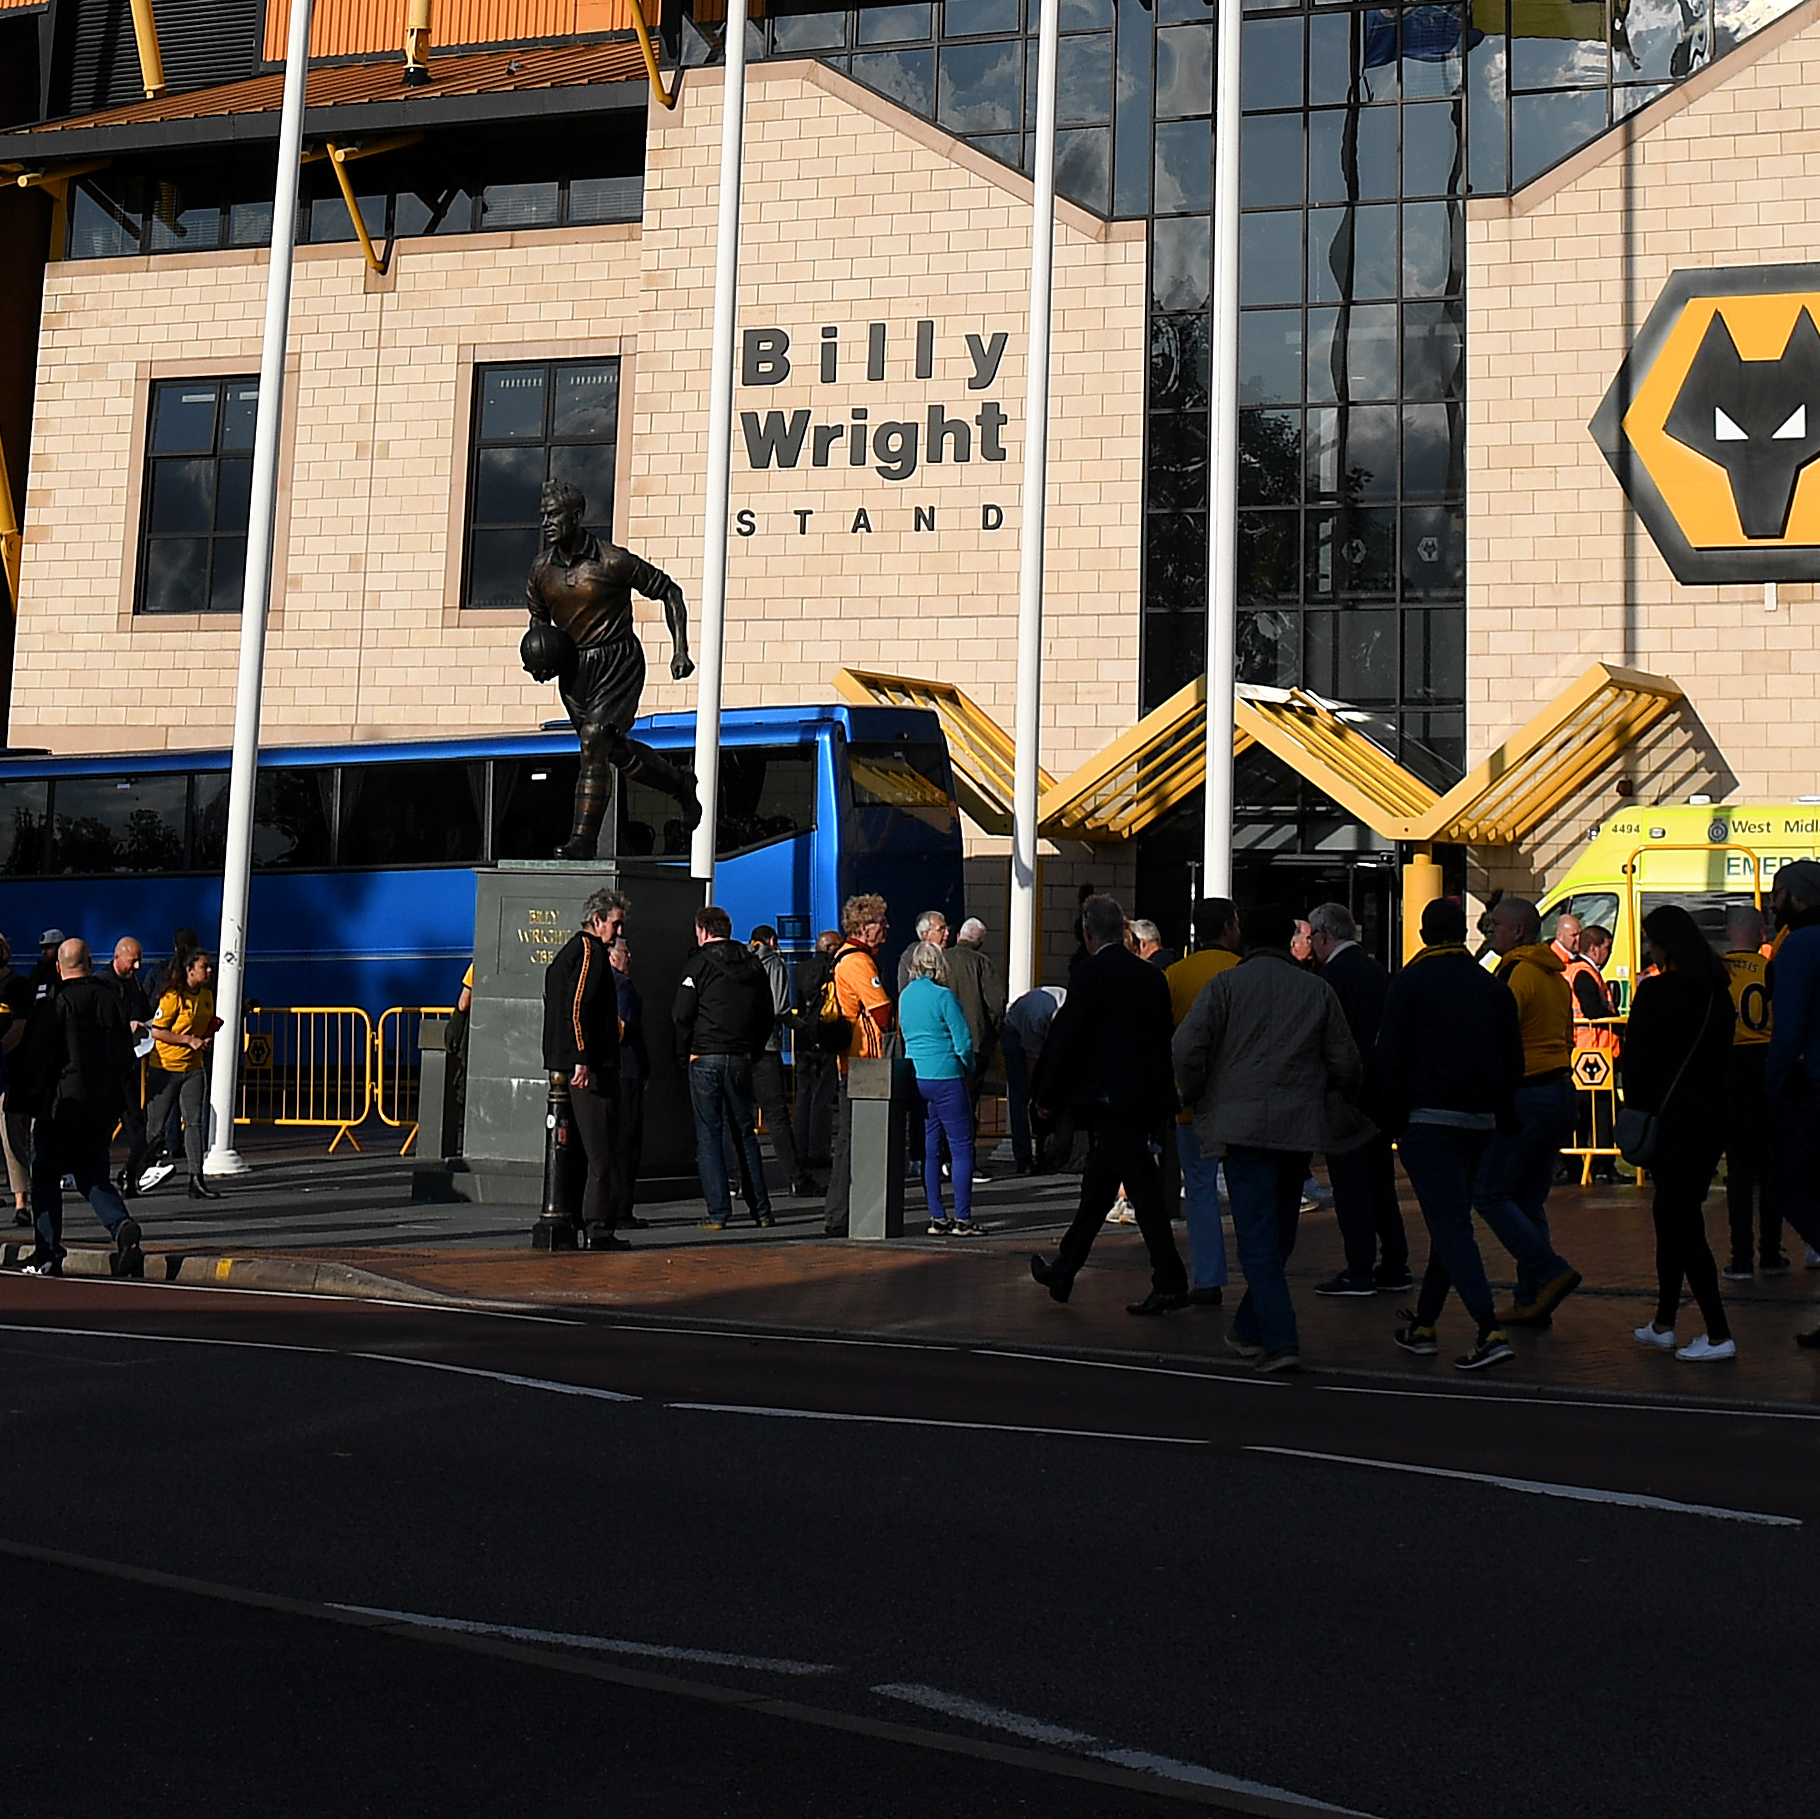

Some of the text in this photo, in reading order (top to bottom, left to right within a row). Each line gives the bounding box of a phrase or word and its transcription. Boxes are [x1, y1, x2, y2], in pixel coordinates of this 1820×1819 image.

[741, 320, 1009, 390] Billy
[740, 401, 1009, 480] Wright
[736, 503, 1004, 537] STAND
[1611, 824, 1641, 834] 4494
[1731, 820, 1772, 834] West
[529, 909, 560, 924] BILLY
[517, 928, 571, 944] WRIGHT
